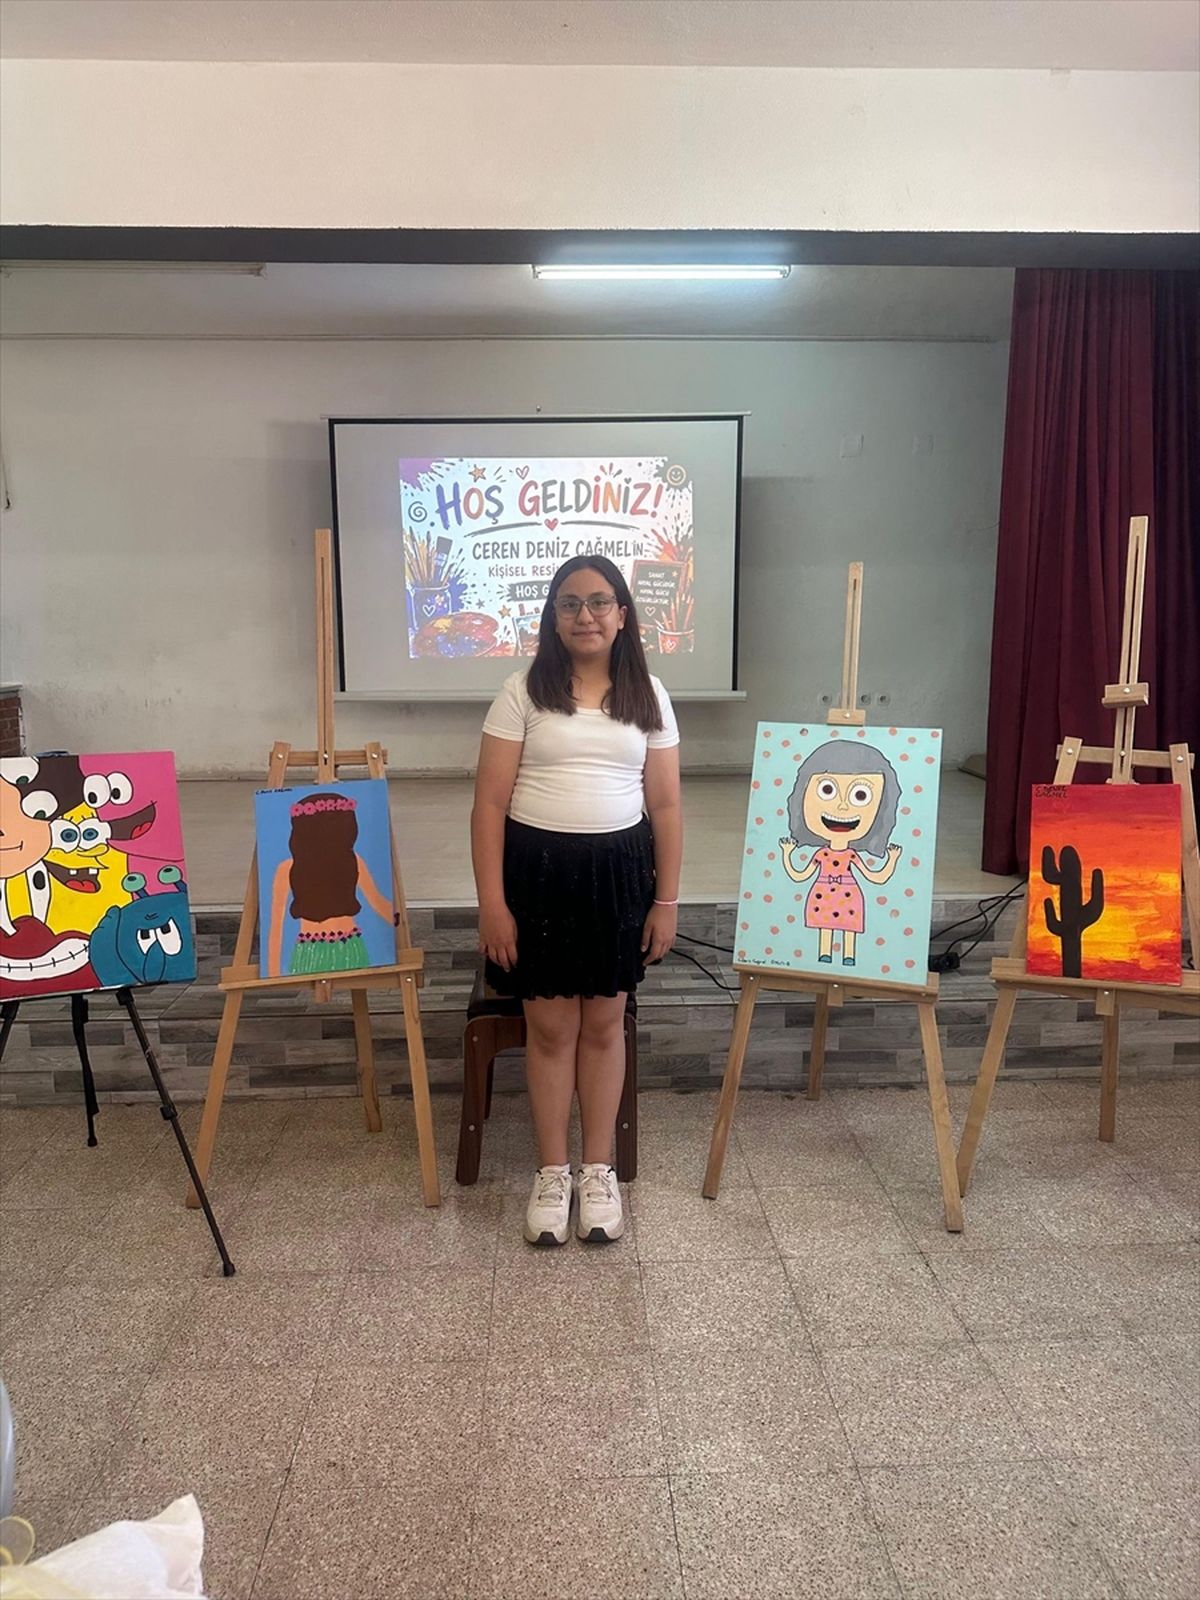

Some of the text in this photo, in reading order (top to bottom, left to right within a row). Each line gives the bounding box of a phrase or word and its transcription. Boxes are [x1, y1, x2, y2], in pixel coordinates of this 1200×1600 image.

[435, 475, 664, 530] HOŞ GELDİNİZ!
[472, 541, 520, 560] CEREN
[526, 536, 571, 560] DENİZ
[488, 562, 560, 579] KİŞİSEL RESİ
[515, 584, 539, 599] HOŞ
